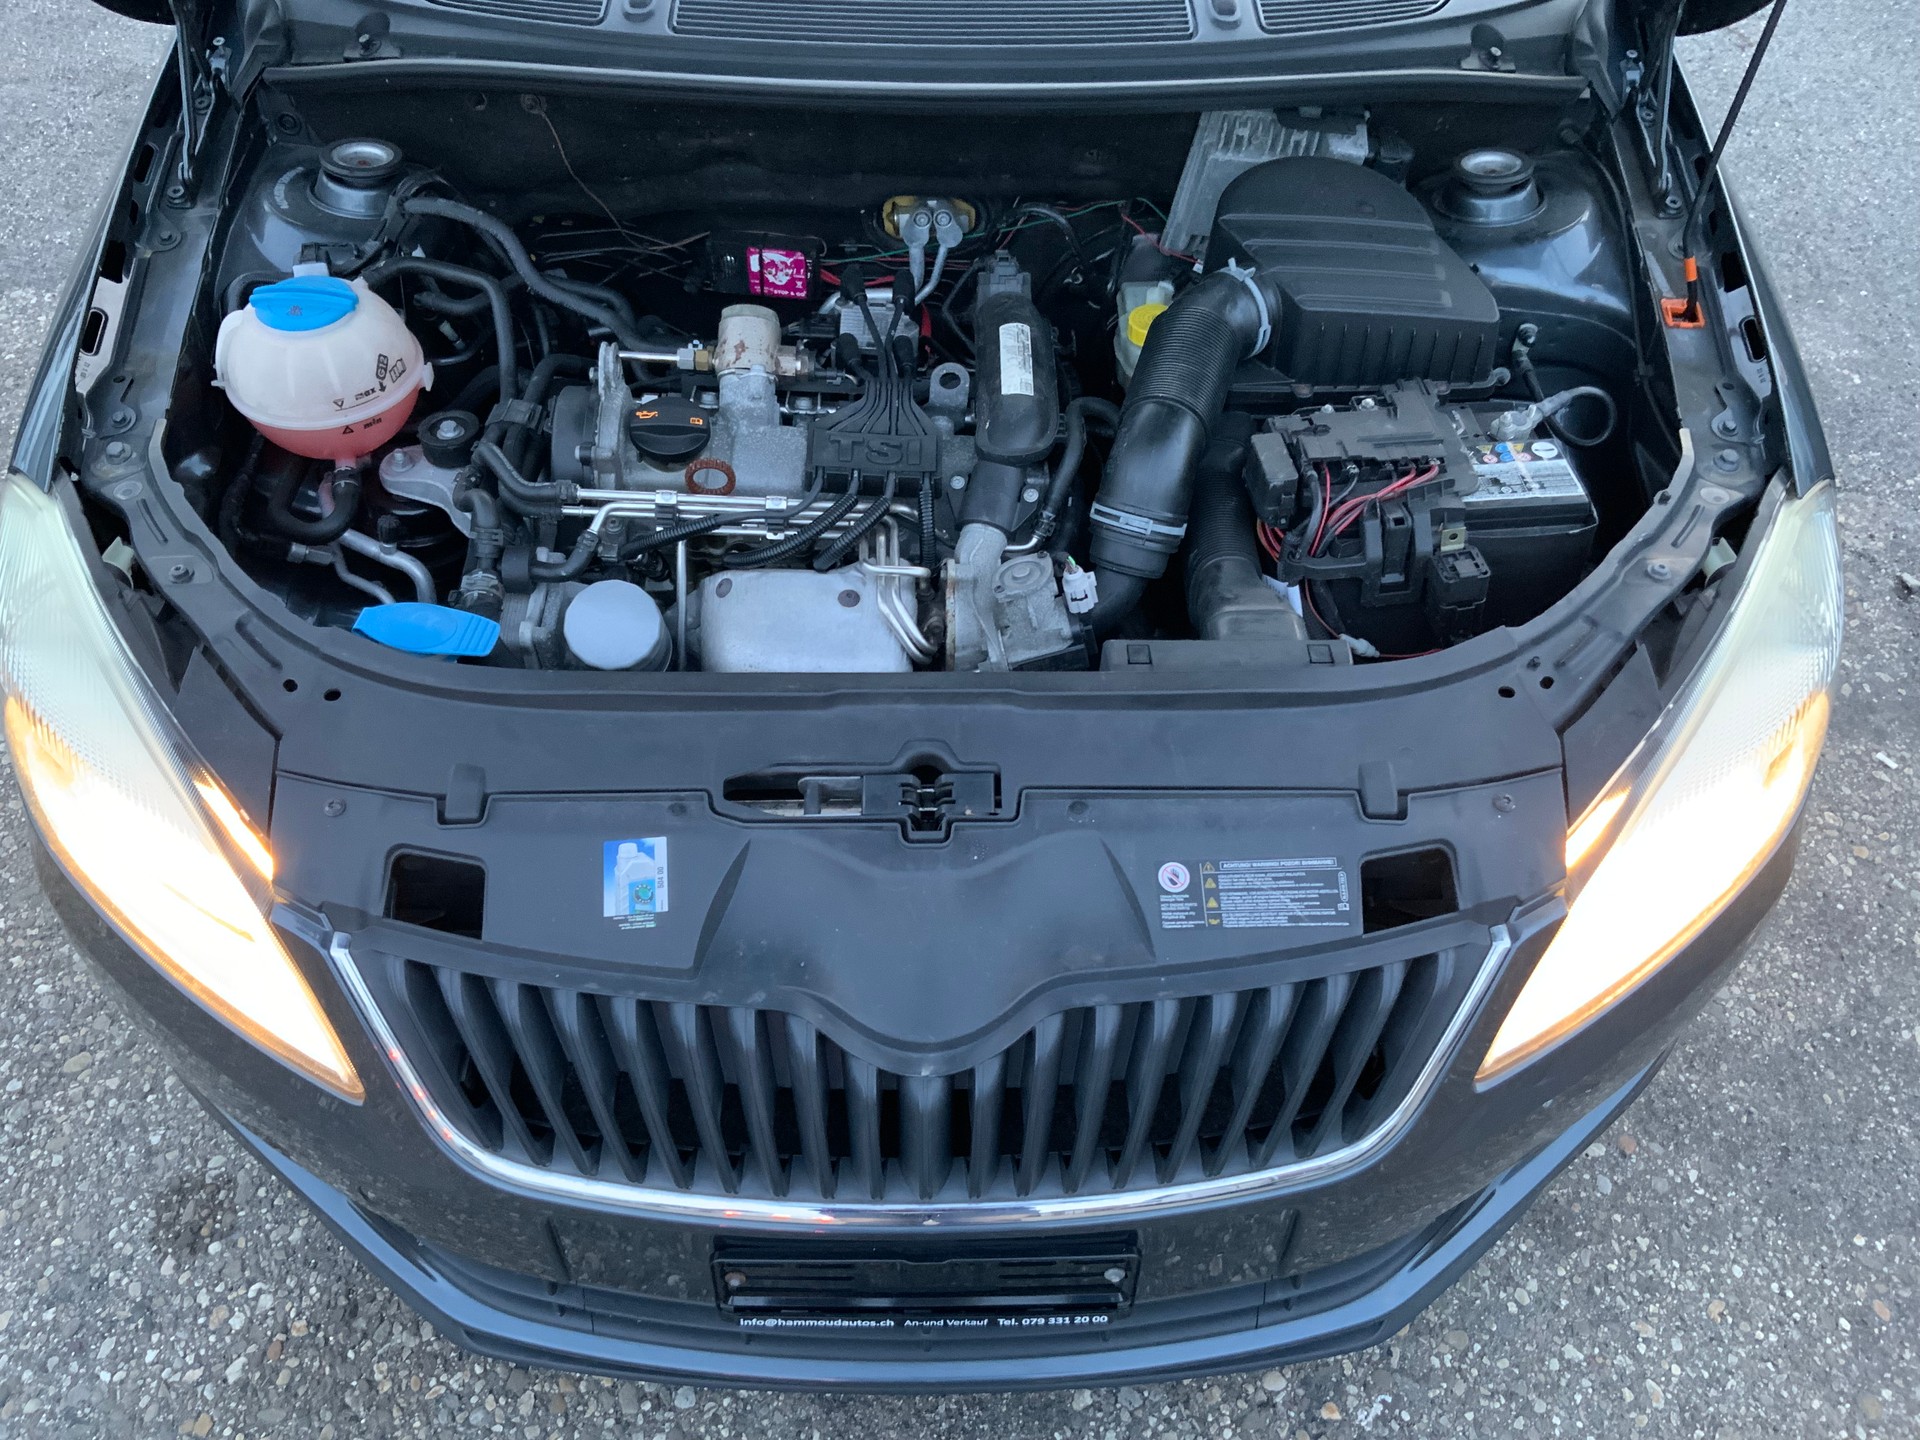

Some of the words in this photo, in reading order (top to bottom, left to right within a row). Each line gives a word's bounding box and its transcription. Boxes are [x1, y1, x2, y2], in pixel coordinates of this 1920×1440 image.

[363, 417, 382, 429] min
[829, 433, 922, 466] TSI
[904, 1319, 944, 1327] An-und
[946, 1318, 989, 1327] Verkauf
[997, 1317, 1019, 1326] Tel.
[1021, 1317, 1045, 1326] 079
[1047, 1316, 1071, 1325] 331
[1073, 1315, 1090, 1324] 20
[1091, 1314, 1108, 1323] 00
